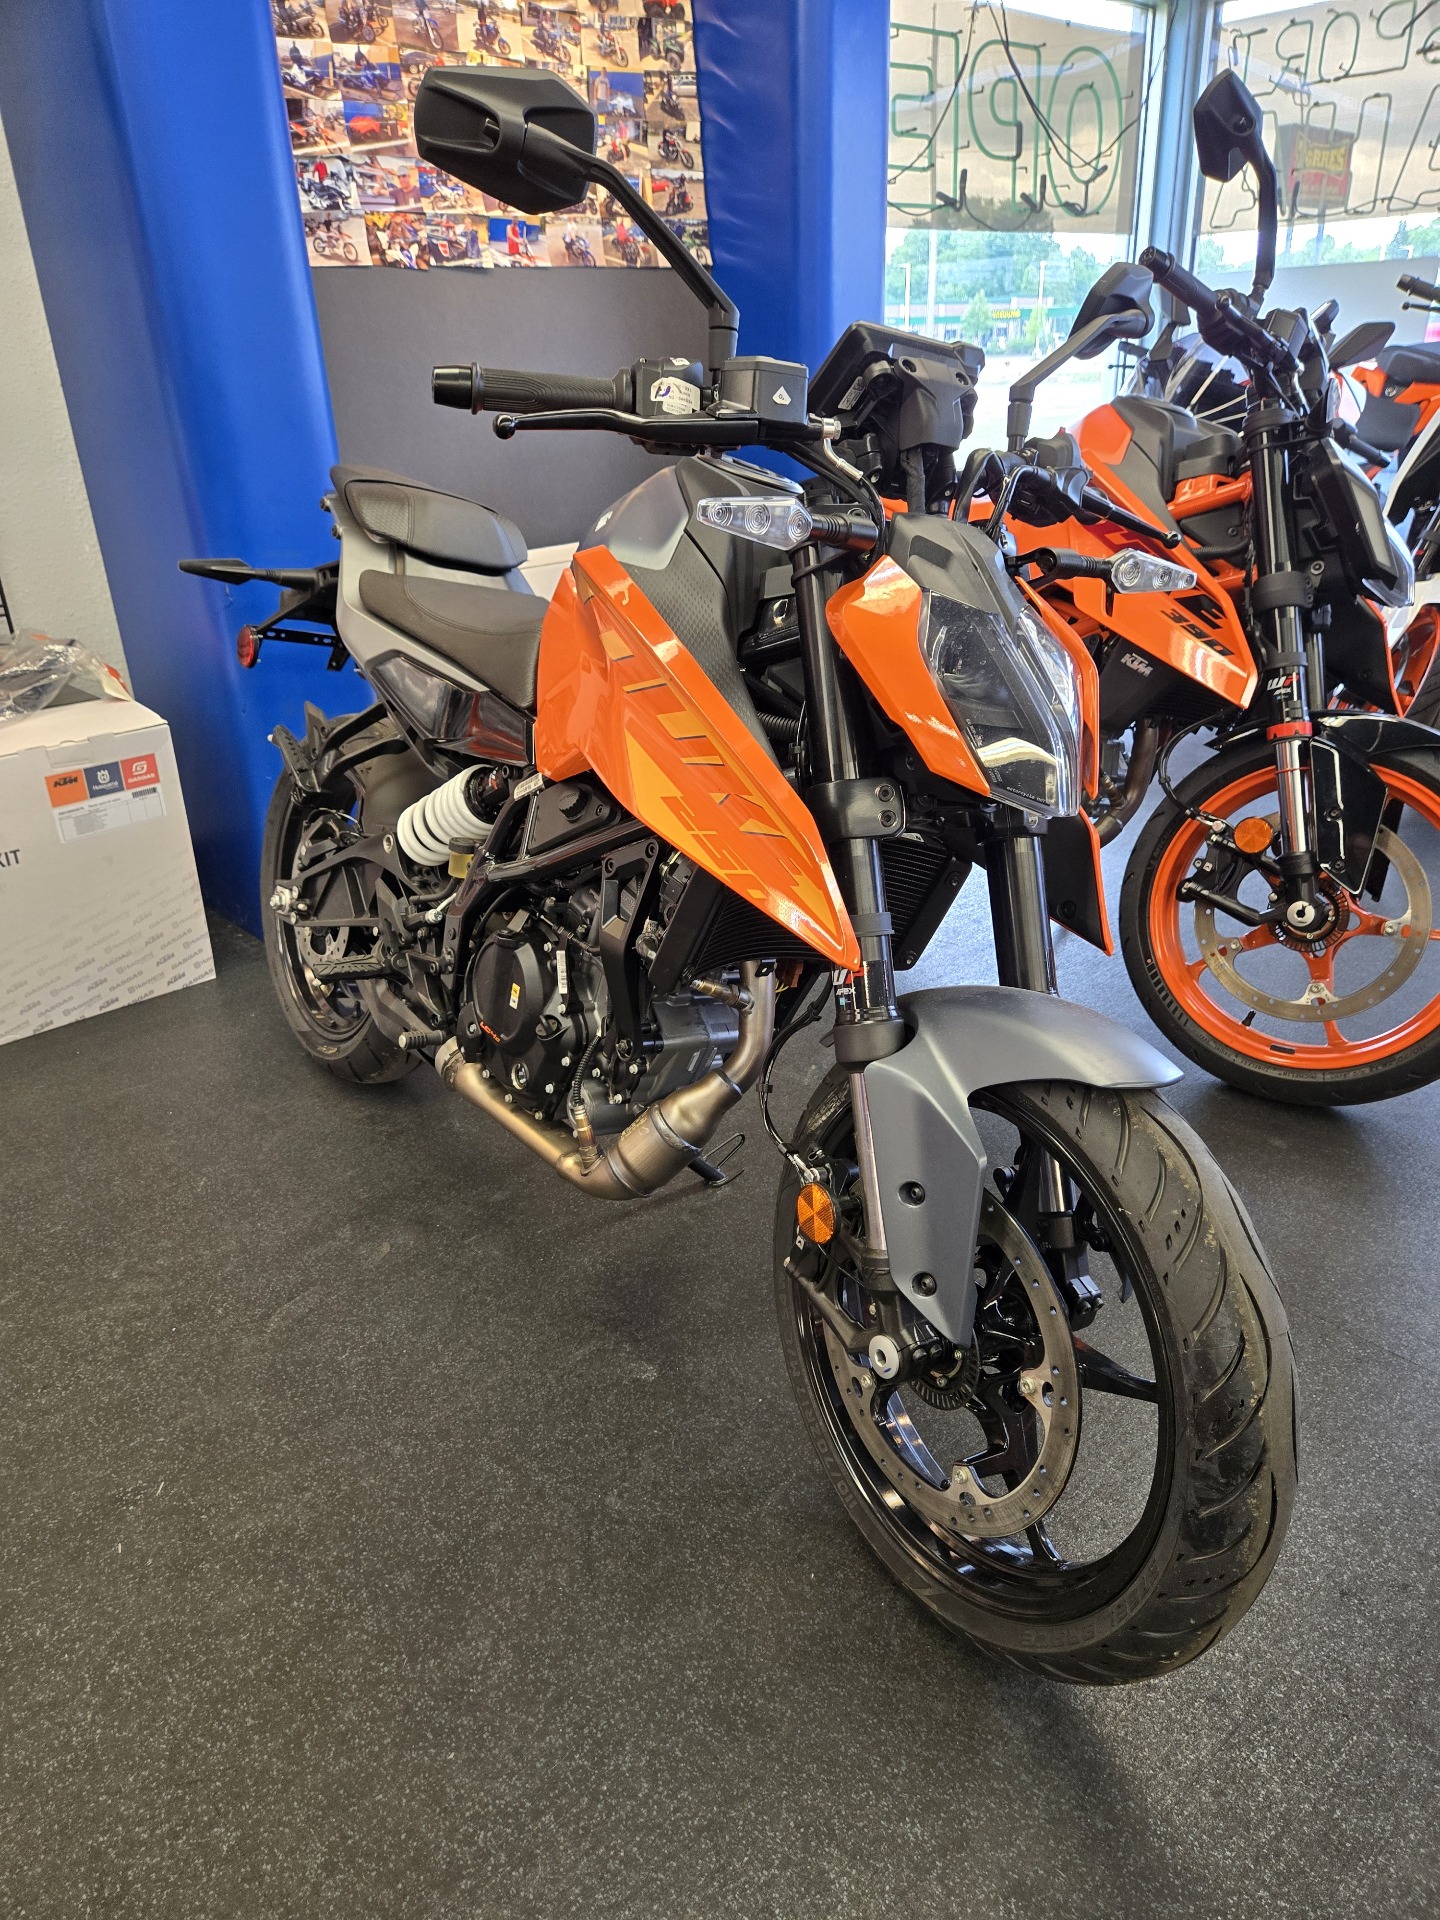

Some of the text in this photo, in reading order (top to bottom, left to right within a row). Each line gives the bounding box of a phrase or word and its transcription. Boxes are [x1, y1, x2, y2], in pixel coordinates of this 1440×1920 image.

[1160, 608, 1235, 656] 390
[1121, 652, 1153, 678] KTM
[53, 776, 78, 788] KTM
[127, 772, 156, 784] GASGAS
